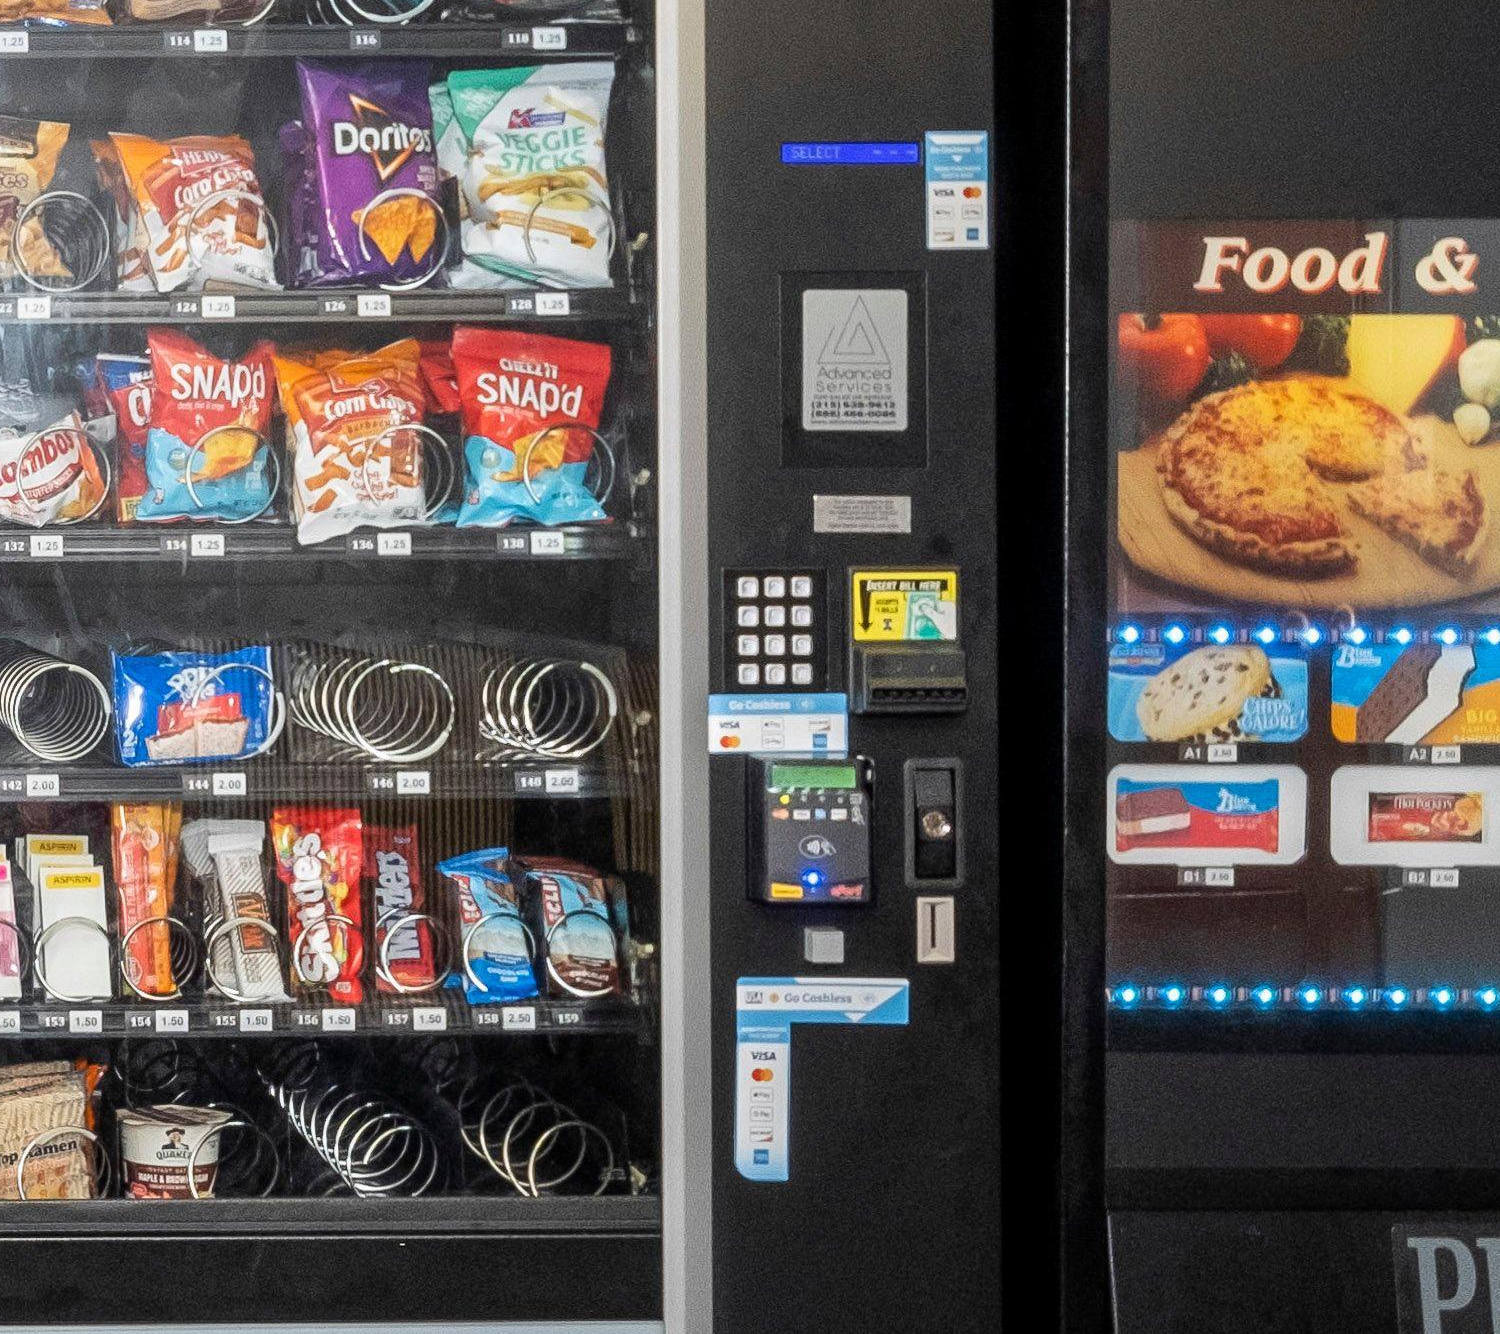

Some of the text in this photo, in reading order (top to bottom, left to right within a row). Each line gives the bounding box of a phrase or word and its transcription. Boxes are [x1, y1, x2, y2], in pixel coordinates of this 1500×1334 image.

[2, 36, 24, 47] 1.25
[200, 35, 222, 46] 1.25
[539, 33, 561, 44] 1.25
[334, 121, 431, 154] Doritos
[496, 128, 587, 150] VEGGIE
[791, 146, 839, 159] SELECT
[500, 150, 586, 172] STICKS
[933, 188, 955, 198] VISA
[1194, 233, 1388, 295] Food
[1416, 244, 1479, 293] &
[23, 302, 46, 313] 1.25
[176, 302, 197, 312] 124
[208, 302, 230, 312] 1.25
[364, 300, 386, 311] 1.25
[542, 300, 564, 310] 1.25
[817, 366, 892, 379] Advanced
[816, 381, 892, 393] Services
[324, 396, 366, 420] Corn
[4, 541, 25, 552] 132
[36, 540, 58, 550] 1.25
[198, 539, 219, 550] 1.25
[353, 540, 373, 550] 136
[383, 539, 406, 549] 1.25
[503, 538, 524, 548] 138
[538, 538, 559, 548] 1.25
[866, 580, 941, 591] INSERT BILL HERE
[729, 700, 791, 709] Go Cashless
[1243, 698, 1291, 716] CHIPS
[1465, 710, 1498, 723] BIG
[720, 721, 740, 729] VISA
[1184, 748, 1201, 759] A1
[3, 779, 22, 790] 142
[32, 780, 55, 790] 2.00
[218, 779, 242, 790] 2.00
[403, 778, 425, 788] 2.00
[551, 776, 574, 787] 2.00
[291, 833, 339, 981] Skittles
[784, 991, 852, 1003] Go Cashless
[75, 1017, 98, 1027] 1.50
[162, 1016, 184, 1027] 1.50
[215, 1015, 236, 1026] 155
[245, 1015, 268, 1026] 1.50
[299, 1014, 319, 1025] 156
[328, 1014, 350, 1025] 1.50
[388, 1014, 408, 1025] 157
[419, 1014, 441, 1024] 1.50
[478, 1013, 499, 1023] 158
[508, 1013, 530, 1023] 2.50
[558, 1013, 579, 1023] 159
[751, 1051, 776, 1061] VISA
